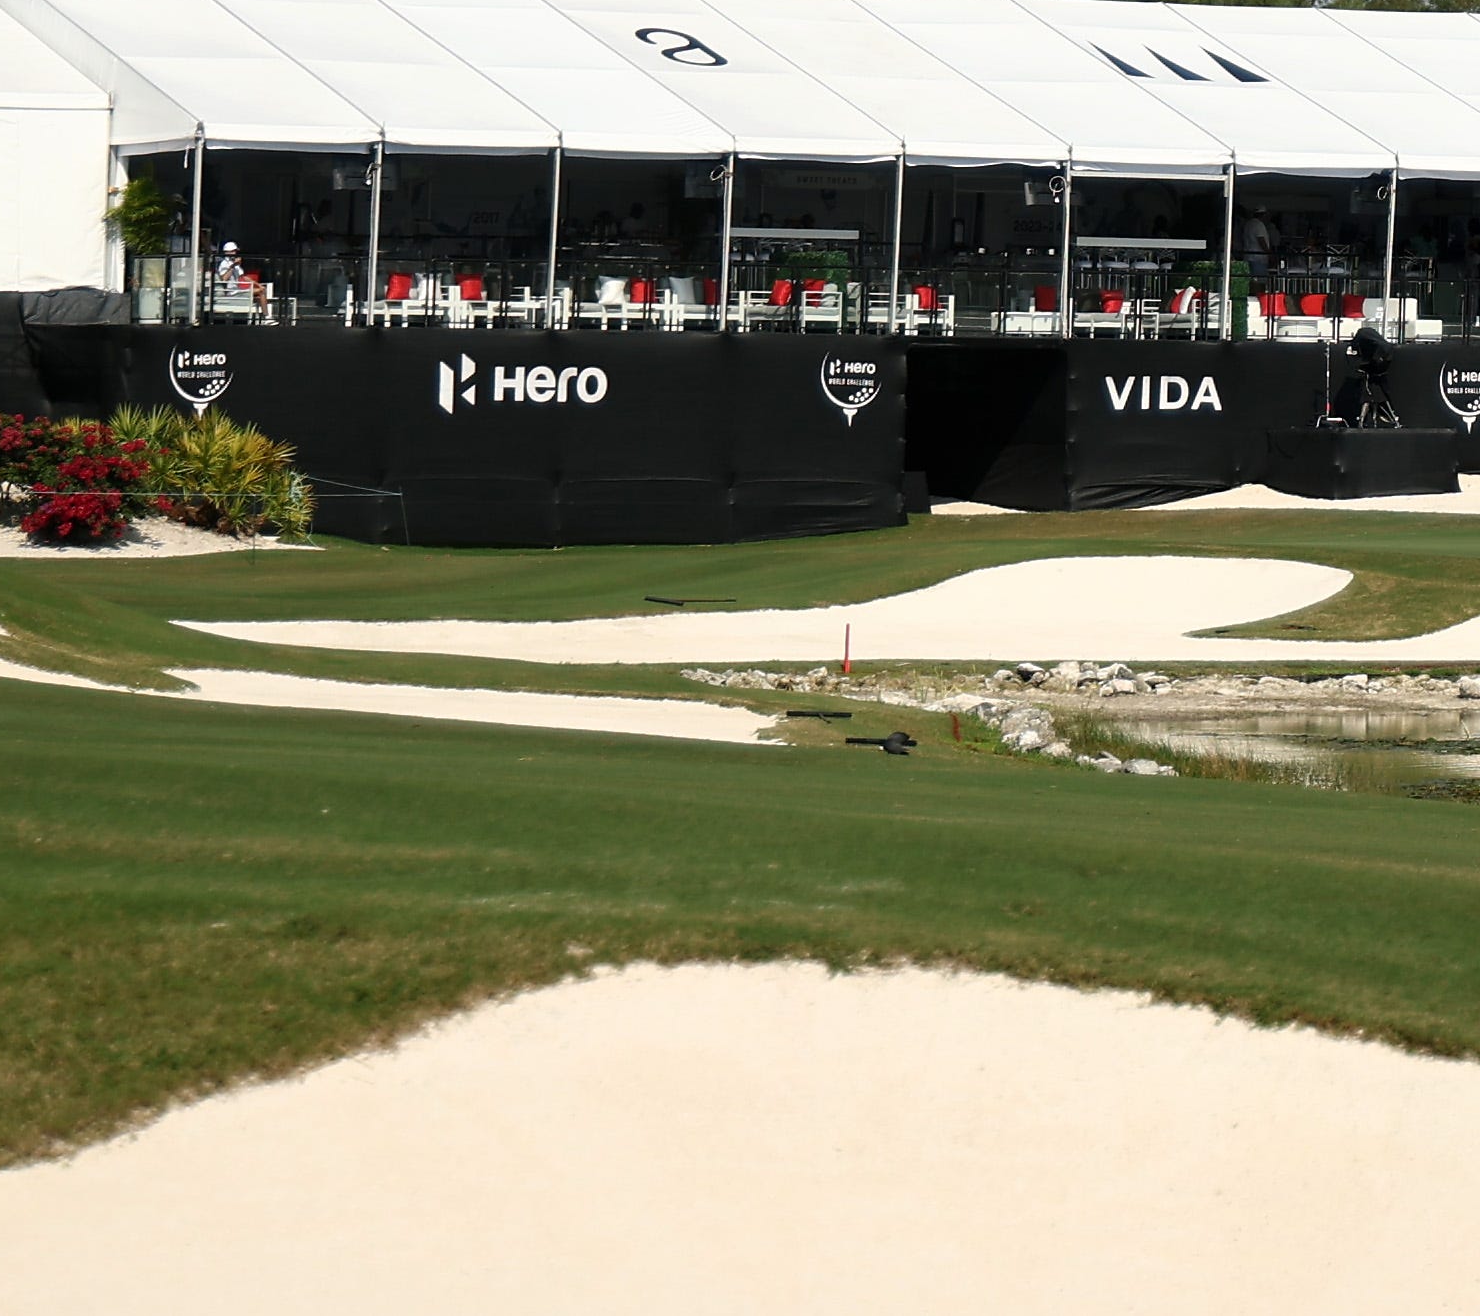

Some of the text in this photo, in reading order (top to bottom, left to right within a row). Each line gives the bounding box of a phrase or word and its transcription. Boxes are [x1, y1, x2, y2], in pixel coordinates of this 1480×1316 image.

[193, 353, 226, 366] Hero
[844, 362, 876, 374] Hero
[493, 365, 608, 404] Hero
[1105, 375, 1223, 411] VIDA
